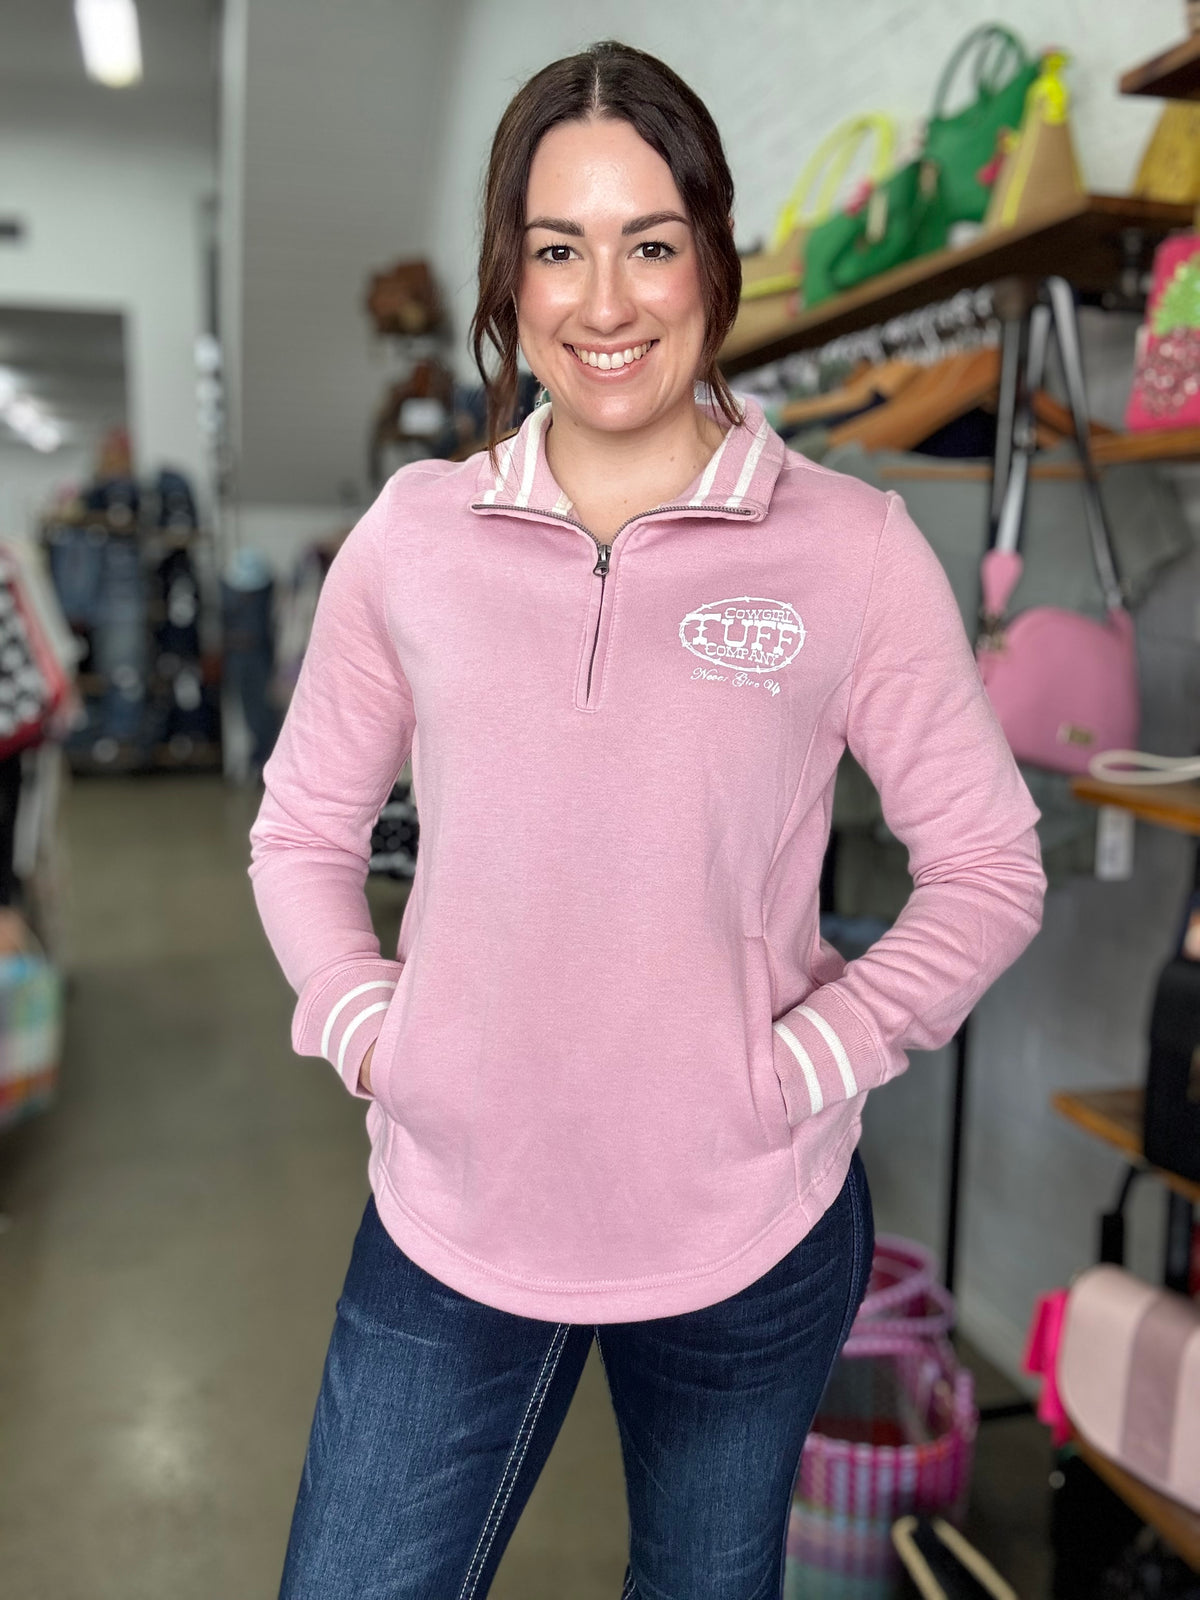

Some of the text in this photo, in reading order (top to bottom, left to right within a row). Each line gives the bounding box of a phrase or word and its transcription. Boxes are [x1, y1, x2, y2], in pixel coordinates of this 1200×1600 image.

[724, 607, 793, 623] COWGIRL
[685, 613, 799, 656] TUFF
[704, 643, 779, 666] COMPANY
